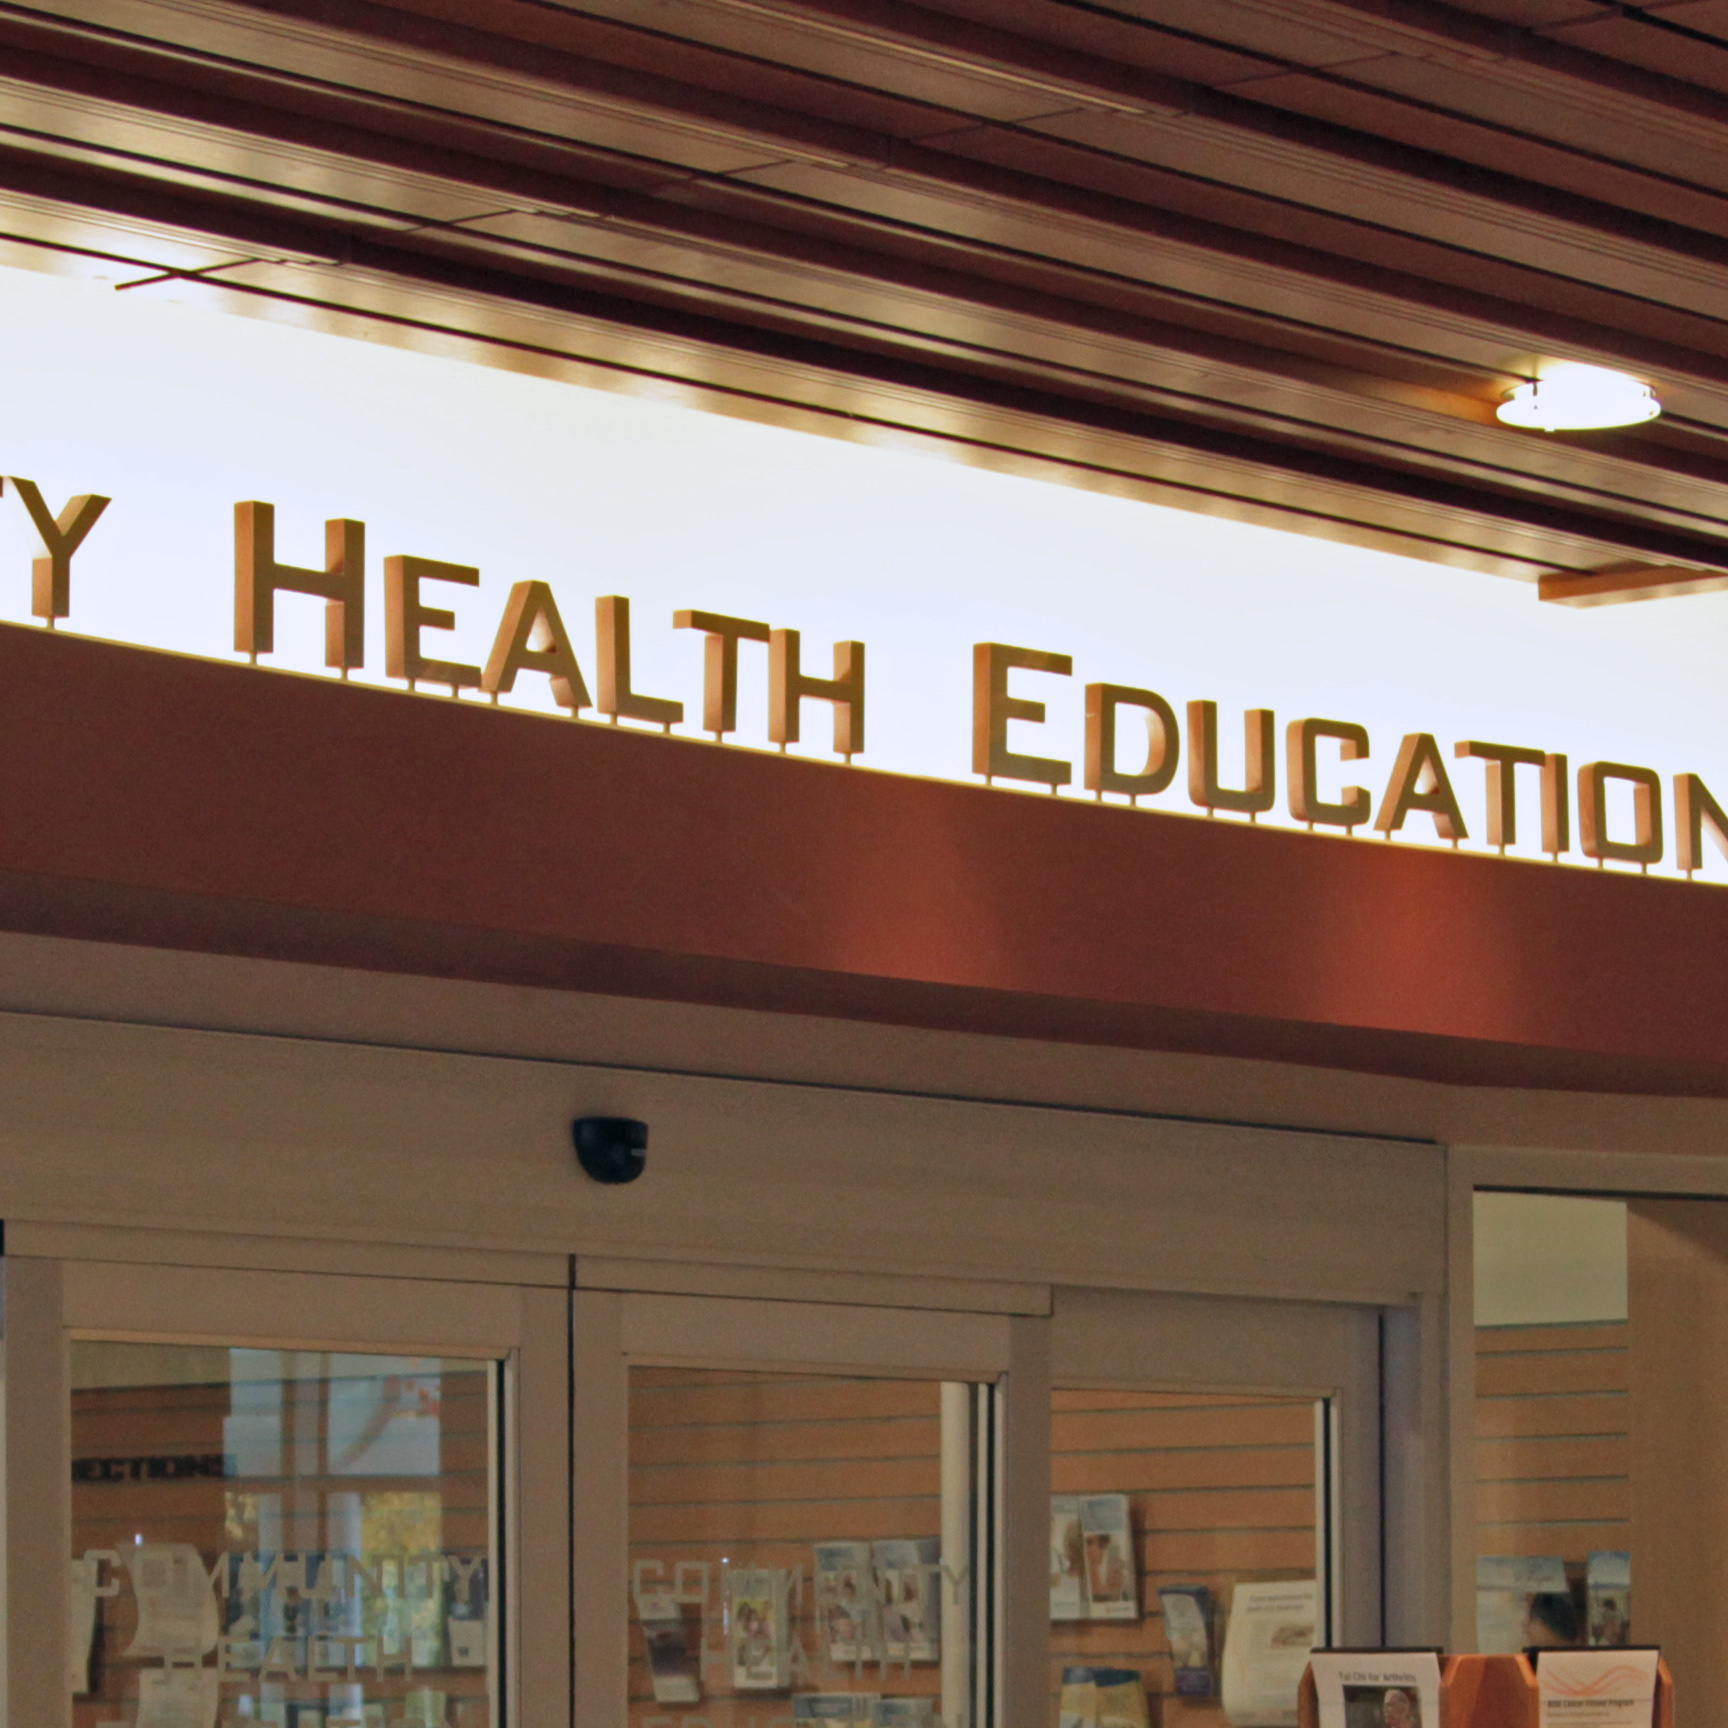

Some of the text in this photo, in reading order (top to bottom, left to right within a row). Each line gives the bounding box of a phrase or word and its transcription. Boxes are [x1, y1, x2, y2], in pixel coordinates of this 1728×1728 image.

[233, 500, 865, 754] HEALTH
[83, 1549, 488, 1602] COMMUNITY
[164, 1635, 413, 1683] HEALTH
